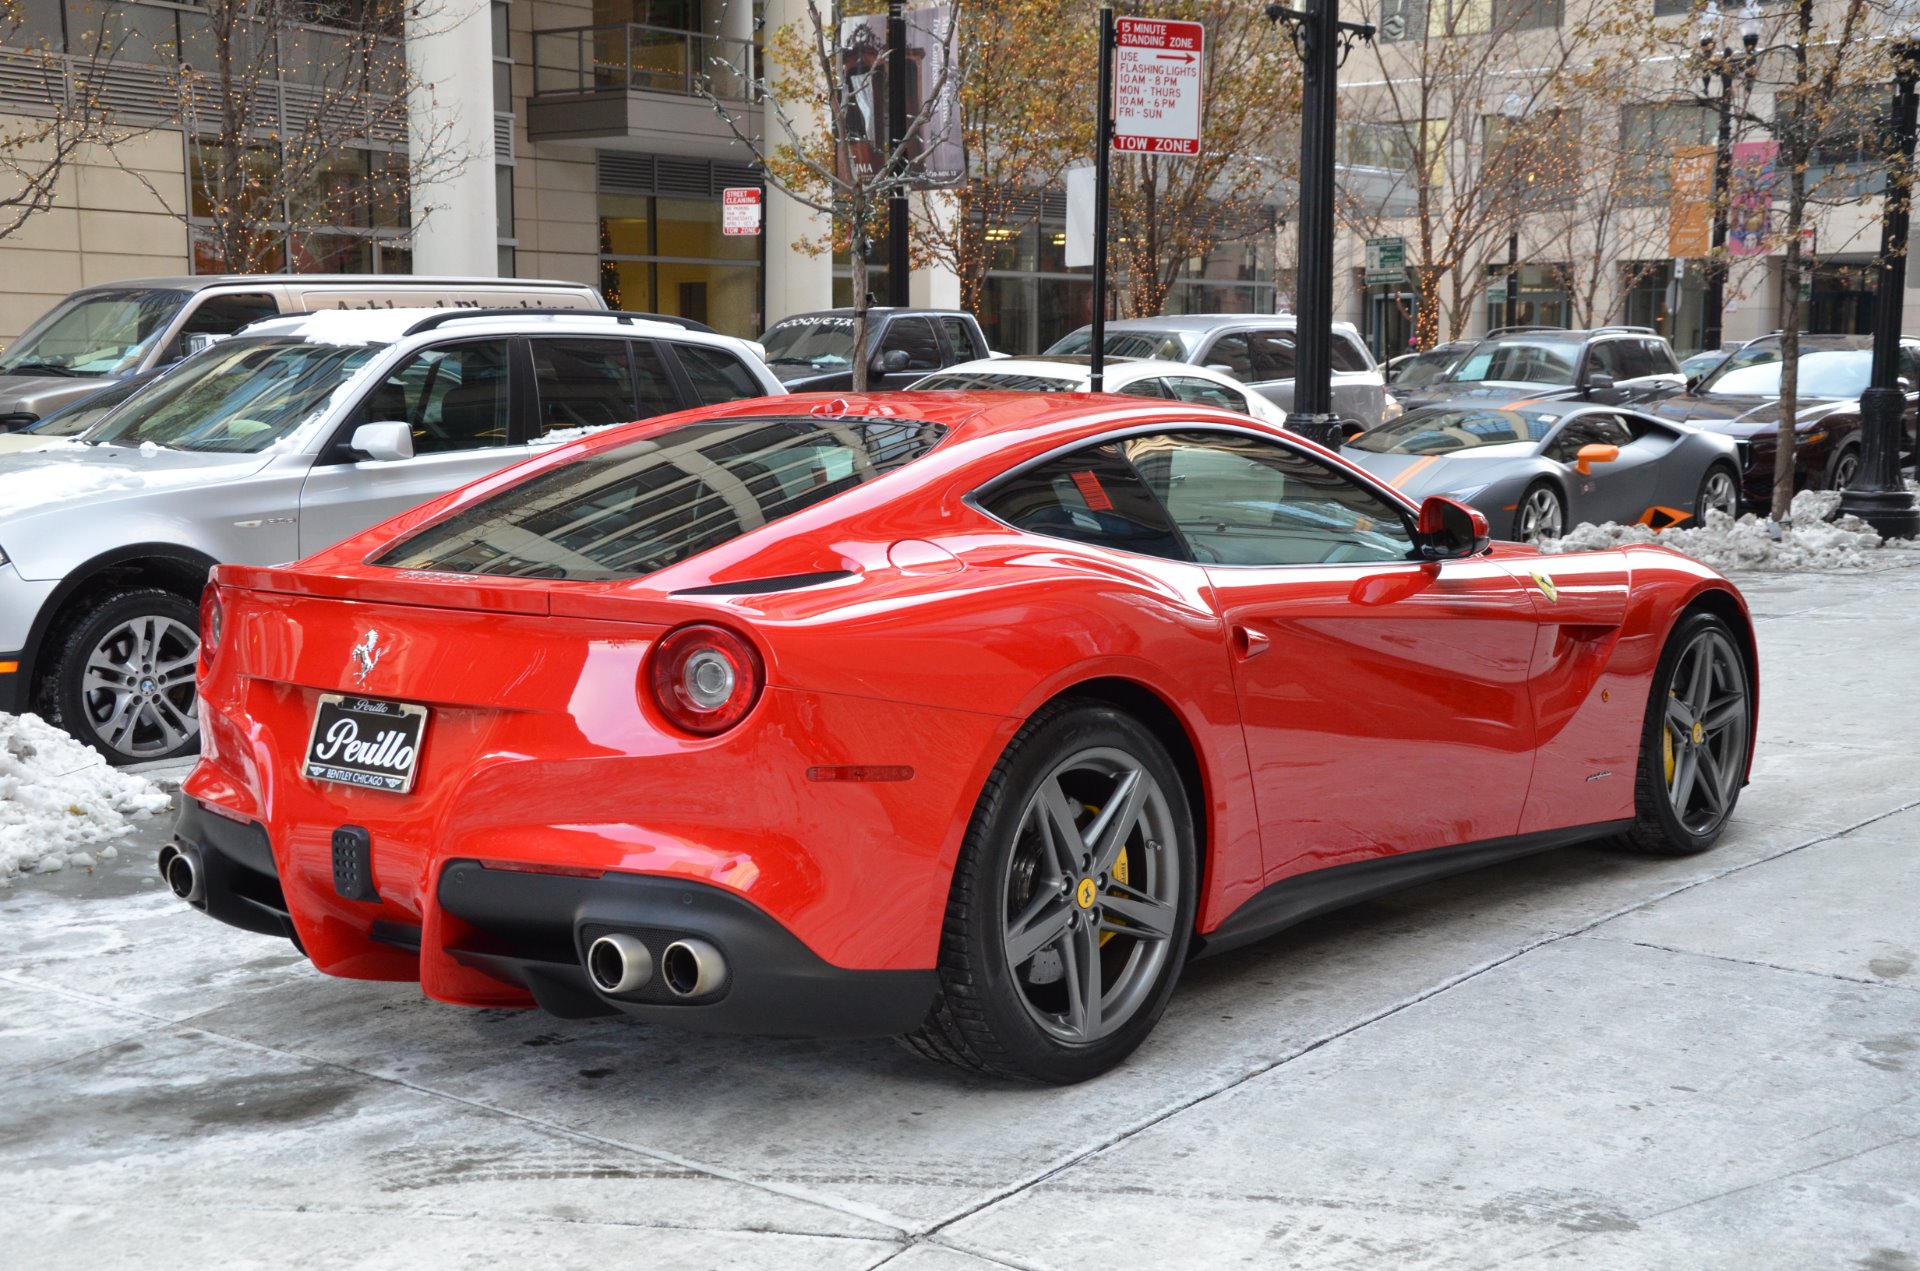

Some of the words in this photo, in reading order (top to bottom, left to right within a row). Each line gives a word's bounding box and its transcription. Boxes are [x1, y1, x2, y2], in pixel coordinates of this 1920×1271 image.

[1122, 22, 1131, 33] 15
[1134, 23, 1167, 35] MINUTE
[1121, 34, 1165, 46] STANDING
[1169, 37, 1193, 48] ZONE
[1120, 52, 1139, 62] USE
[1120, 63, 1164, 75] FLASHING
[1166, 65, 1197, 77] LIGHTS
[1120, 74, 1130, 83] 10
[1131, 75, 1146, 84] AM
[1155, 76, 1161, 85] 8
[1164, 77, 1177, 86] PM
[1120, 85, 1140, 95] MON
[1151, 87, 1181, 98] THURS
[1119, 96, 1129, 105] 10
[1130, 97, 1144, 106] AM
[1154, 99, 1160, 108] 6
[1162, 99, 1176, 109] PM
[1119, 107, 1134, 117] FRI
[1143, 108, 1162, 118] SUN
[1118, 136, 1148, 150] TOW
[1154, 139, 1192, 153] ZONE
[726, 190, 747, 198] STREET
[353, 699, 389, 713] Perillo
[316, 718, 414, 770] Perillo
[326, 768, 352, 781] BENTLEY
[352, 773, 384, 786] CHICAGO
